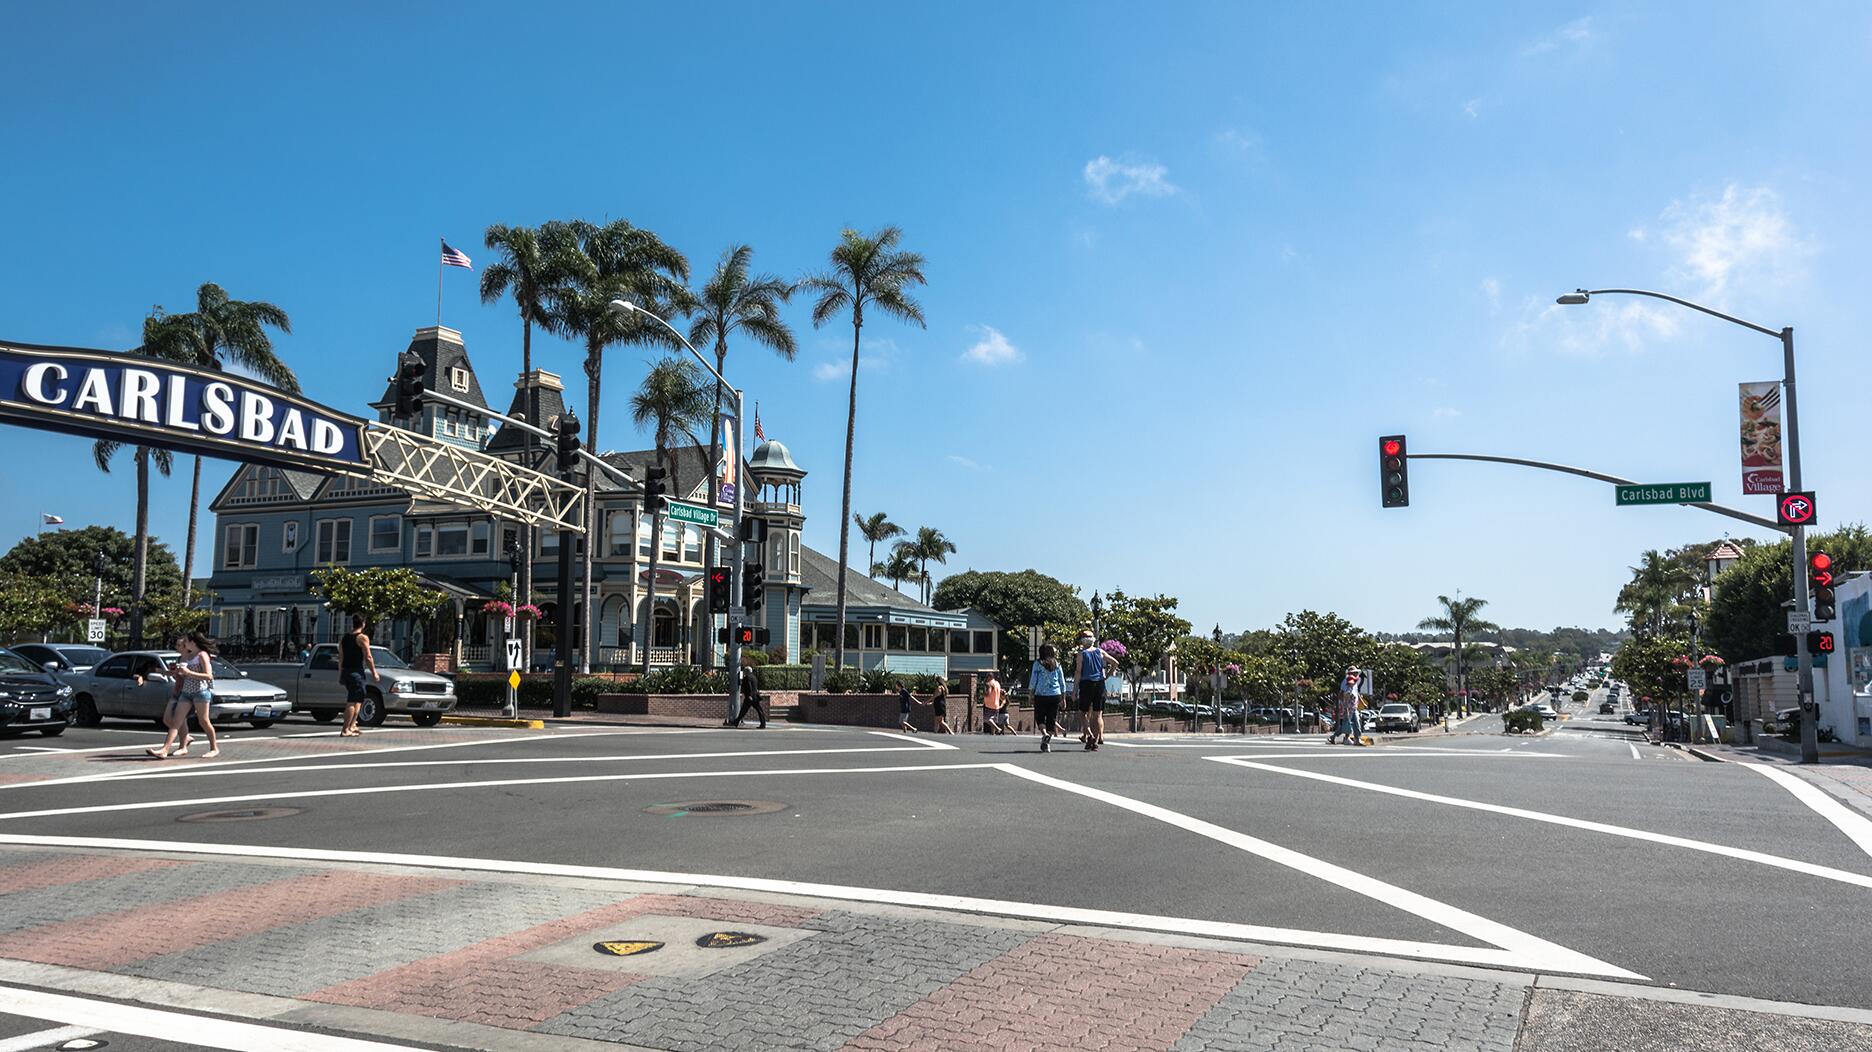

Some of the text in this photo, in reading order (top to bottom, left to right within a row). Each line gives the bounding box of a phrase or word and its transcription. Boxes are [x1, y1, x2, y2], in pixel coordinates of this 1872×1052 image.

[22, 362, 344, 454] CARLSBAD
[1747, 482, 1781, 493] Village
[1621, 486, 1705, 501] Carlsbad Blvd
[671, 505, 716, 523] Carlsbad Village Dr
[1790, 623, 1800, 632] OK
[90, 630, 104, 639] 30
[743, 630, 752, 641] 20
[1819, 636, 1833, 650] 20
[1690, 679, 1704, 688] 25
